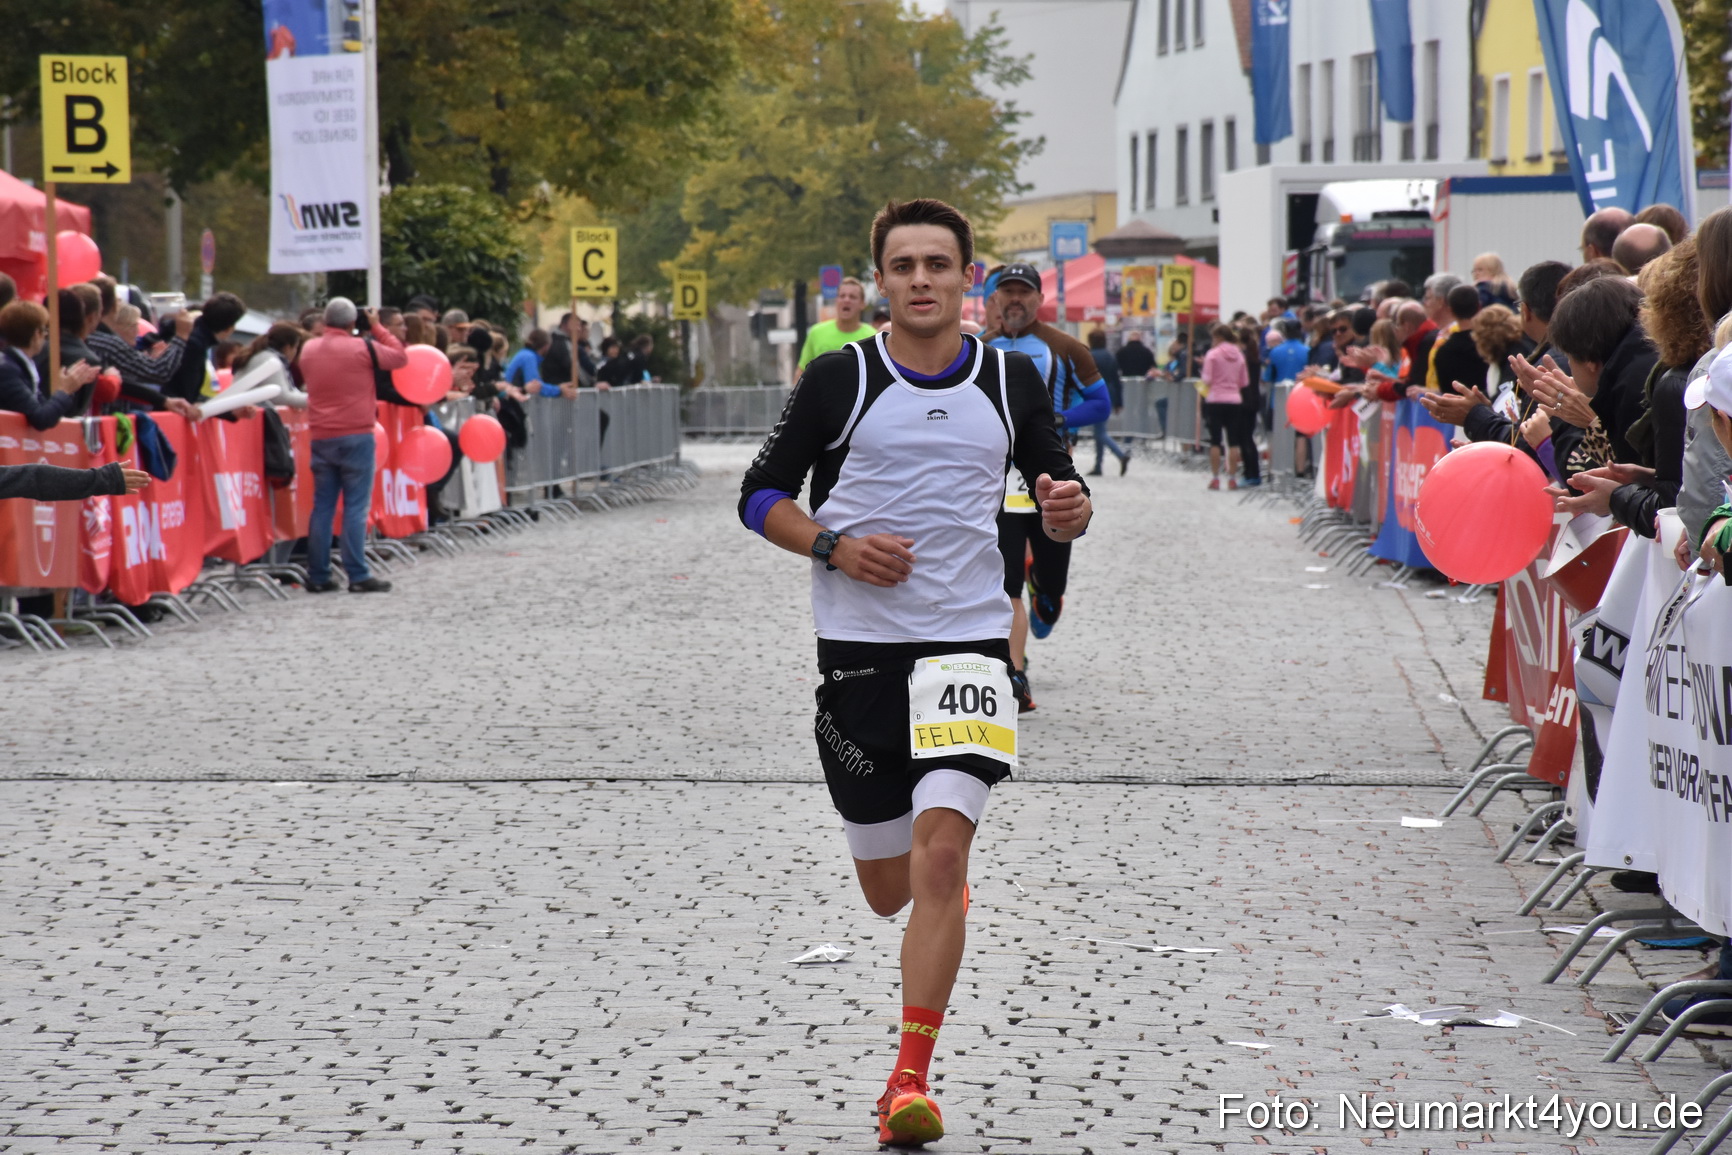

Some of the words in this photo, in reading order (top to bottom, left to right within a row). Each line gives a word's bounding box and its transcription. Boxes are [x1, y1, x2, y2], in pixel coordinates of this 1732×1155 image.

[51, 61, 118, 84] Block
[65, 94, 108, 154] B
[576, 231, 611, 243] Block
[582, 248, 605, 281] C
[682, 285, 698, 308] D
[1170, 279, 1187, 302] D
[843, 667, 875, 676] CHALLENGE
[952, 663, 991, 673] BOCK
[938, 684, 997, 717] 406
[915, 725, 990, 747] FELIX
